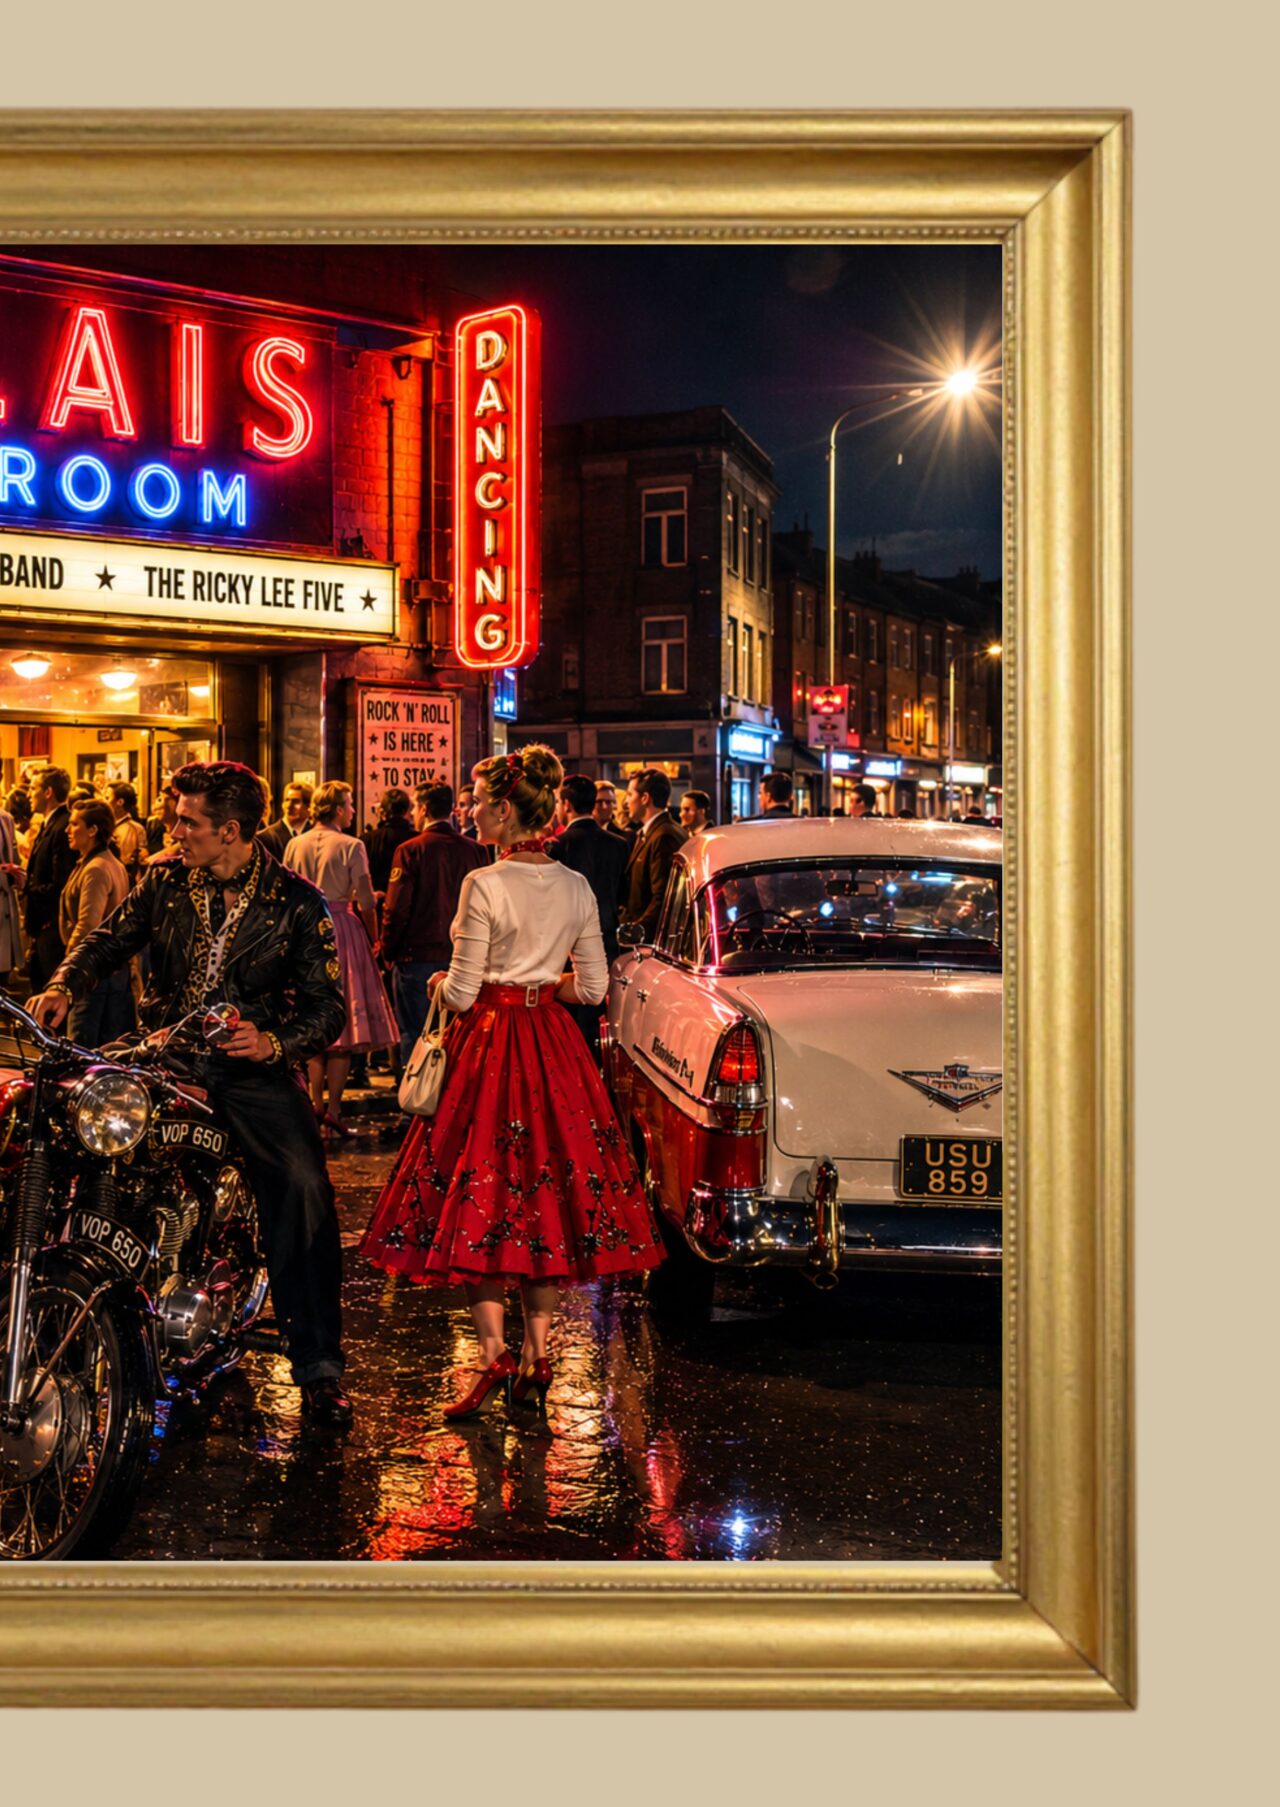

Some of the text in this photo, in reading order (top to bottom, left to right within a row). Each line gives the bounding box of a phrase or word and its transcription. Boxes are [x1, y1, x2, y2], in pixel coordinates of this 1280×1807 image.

[473, 329, 509, 653] DANCING
[143, 565, 186, 600] THE
[192, 569, 254, 605] RICKY
[261, 576, 295, 609] LEE
[302, 579, 345, 613] FIVE
[366, 699, 400, 721] ROCK
[421, 703, 450, 725] ROLL
[383, 731, 434, 752] IS HERE
[382, 767, 399, 787] TO
[161, 1123, 223, 1153] VOP 650
[925, 1142, 992, 1168] USU
[928, 1169, 988, 1194] 859
[81, 1213, 142, 1268] VOP 650
